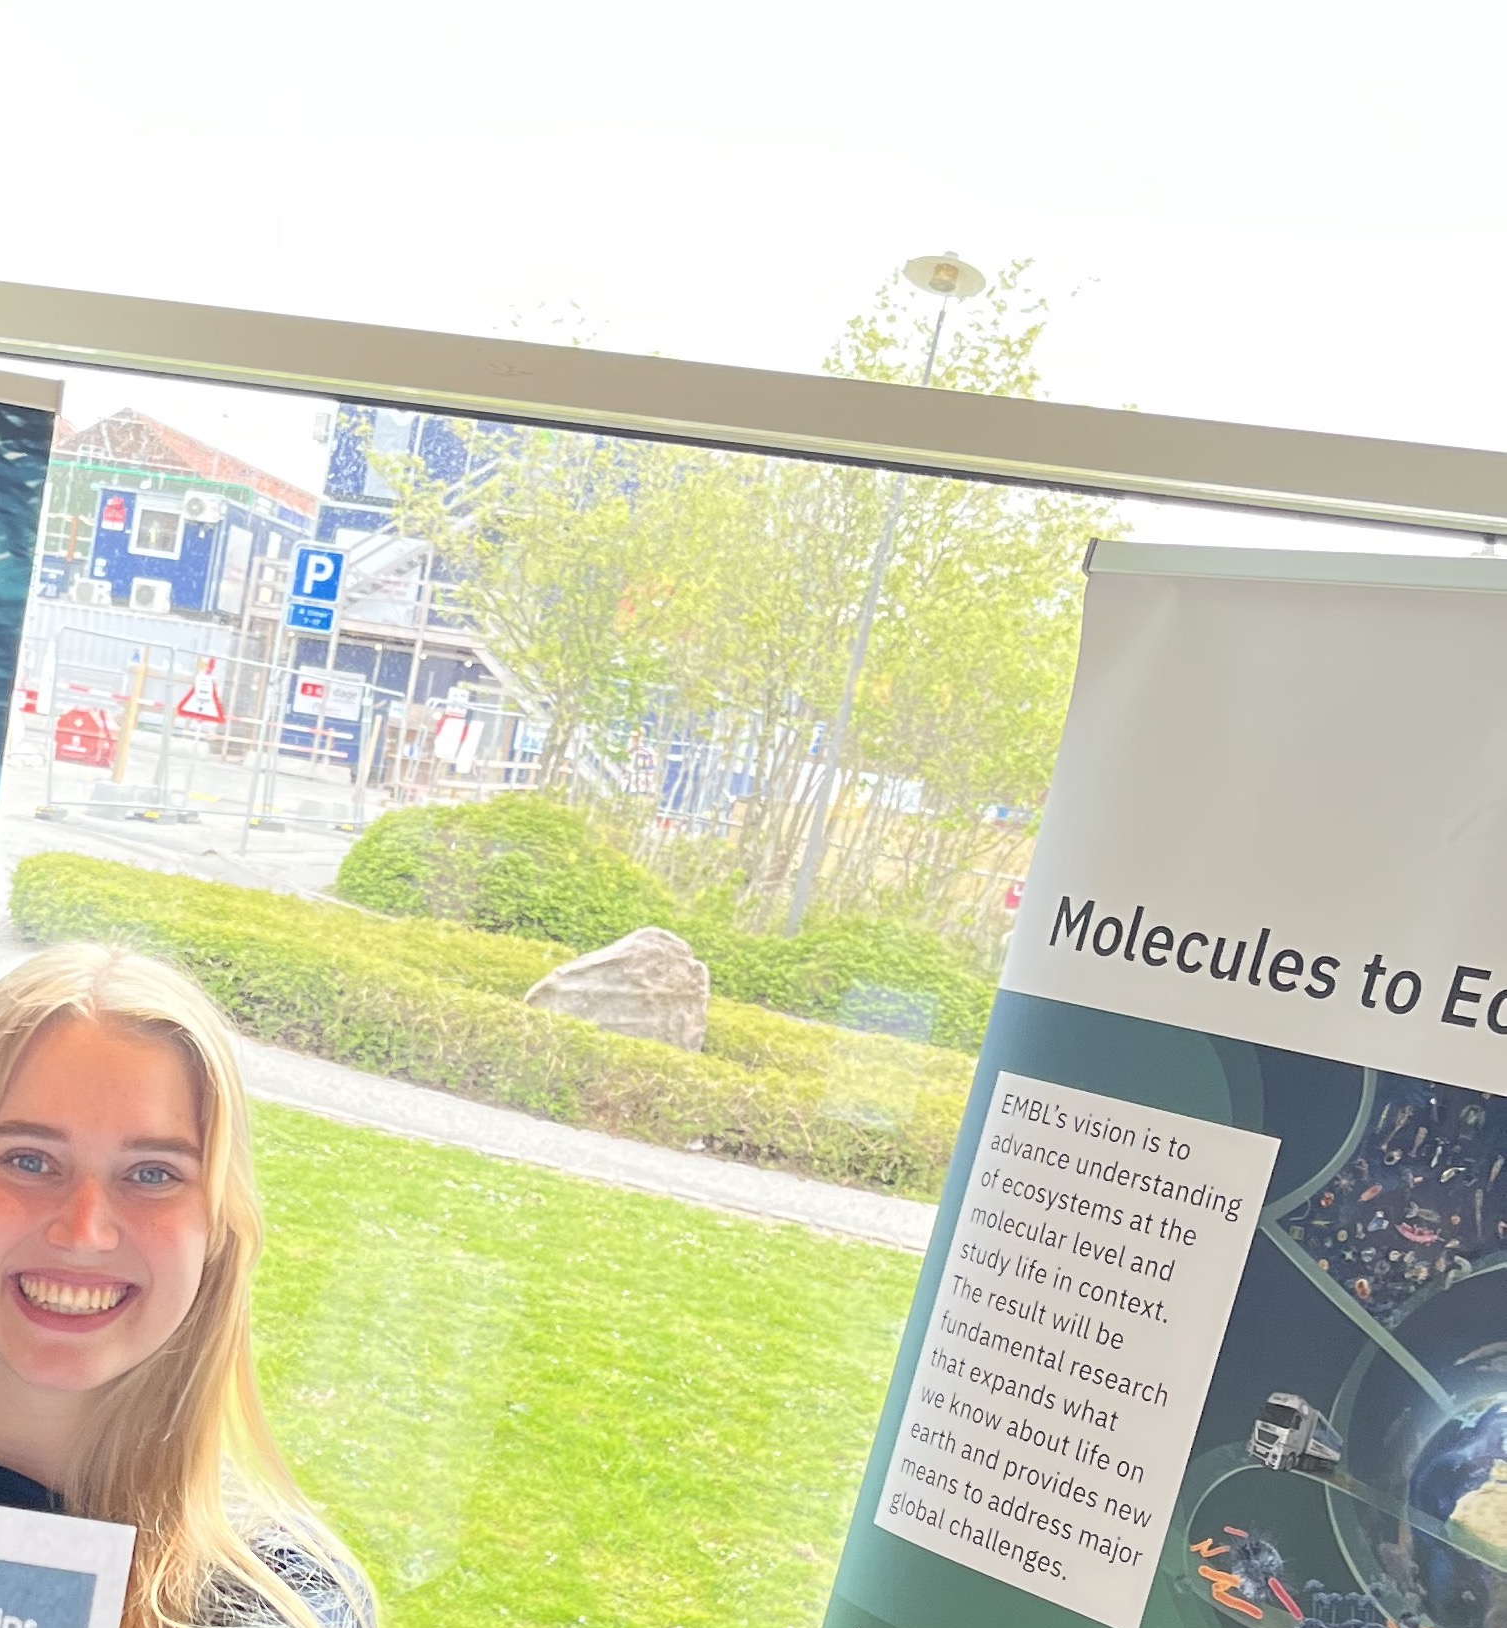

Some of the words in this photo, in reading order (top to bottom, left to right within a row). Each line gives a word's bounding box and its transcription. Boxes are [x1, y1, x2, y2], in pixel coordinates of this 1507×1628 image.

[302, 554, 334, 594] P
[1049, 896, 1341, 1000] Molecules
[1361, 954, 1422, 1015] to
[1002, 1093, 1066, 1129] EMBL's
[1074, 1113, 1135, 1147] vision
[1143, 1128, 1161, 1153] is
[1170, 1136, 1191, 1160] to
[981, 1168, 1002, 1190] of
[1003, 1176, 1123, 1227] ecosystems
[1130, 1211, 1154, 1233] at
[1160, 1218, 1197, 1247] the
[991, 1133, 1070, 1169] advance
[1076, 1158, 1243, 1222] understanding
[959, 1241, 1011, 1277] study
[1015, 1254, 1047, 1284] life
[1053, 1267, 1073, 1292] in
[1079, 1281, 1169, 1324] context.
[970, 1205, 1069, 1250] molecular
[1073, 1232, 1125, 1268] level
[1130, 1254, 1176, 1283] and
[952, 1274, 983, 1303] The
[988, 1290, 1047, 1326] result
[1052, 1309, 1090, 1341] will
[1095, 1322, 1125, 1349] be
[930, 1348, 966, 1378] that
[969, 1365, 1057, 1411] expands
[1063, 1396, 1119, 1433] what
[940, 1309, 1066, 1373] fundamental
[1069, 1359, 1169, 1407] research
[910, 1421, 956, 1454] earth
[960, 1442, 1000, 1470] and
[1002, 1458, 1098, 1510] provides
[1104, 1497, 1153, 1528] new
[921, 1386, 945, 1409] we
[949, 1393, 1003, 1431] know
[1006, 1419, 1072, 1457] about
[1075, 1439, 1110, 1471] life
[1116, 1458, 1144, 1484] on
[889, 1493, 945, 1530] global
[948, 1517, 1067, 1581] challenges.
[900, 1456, 959, 1496] means
[963, 1481, 984, 1504] to
[988, 1493, 1074, 1541] address
[1078, 1531, 1144, 1568] major
